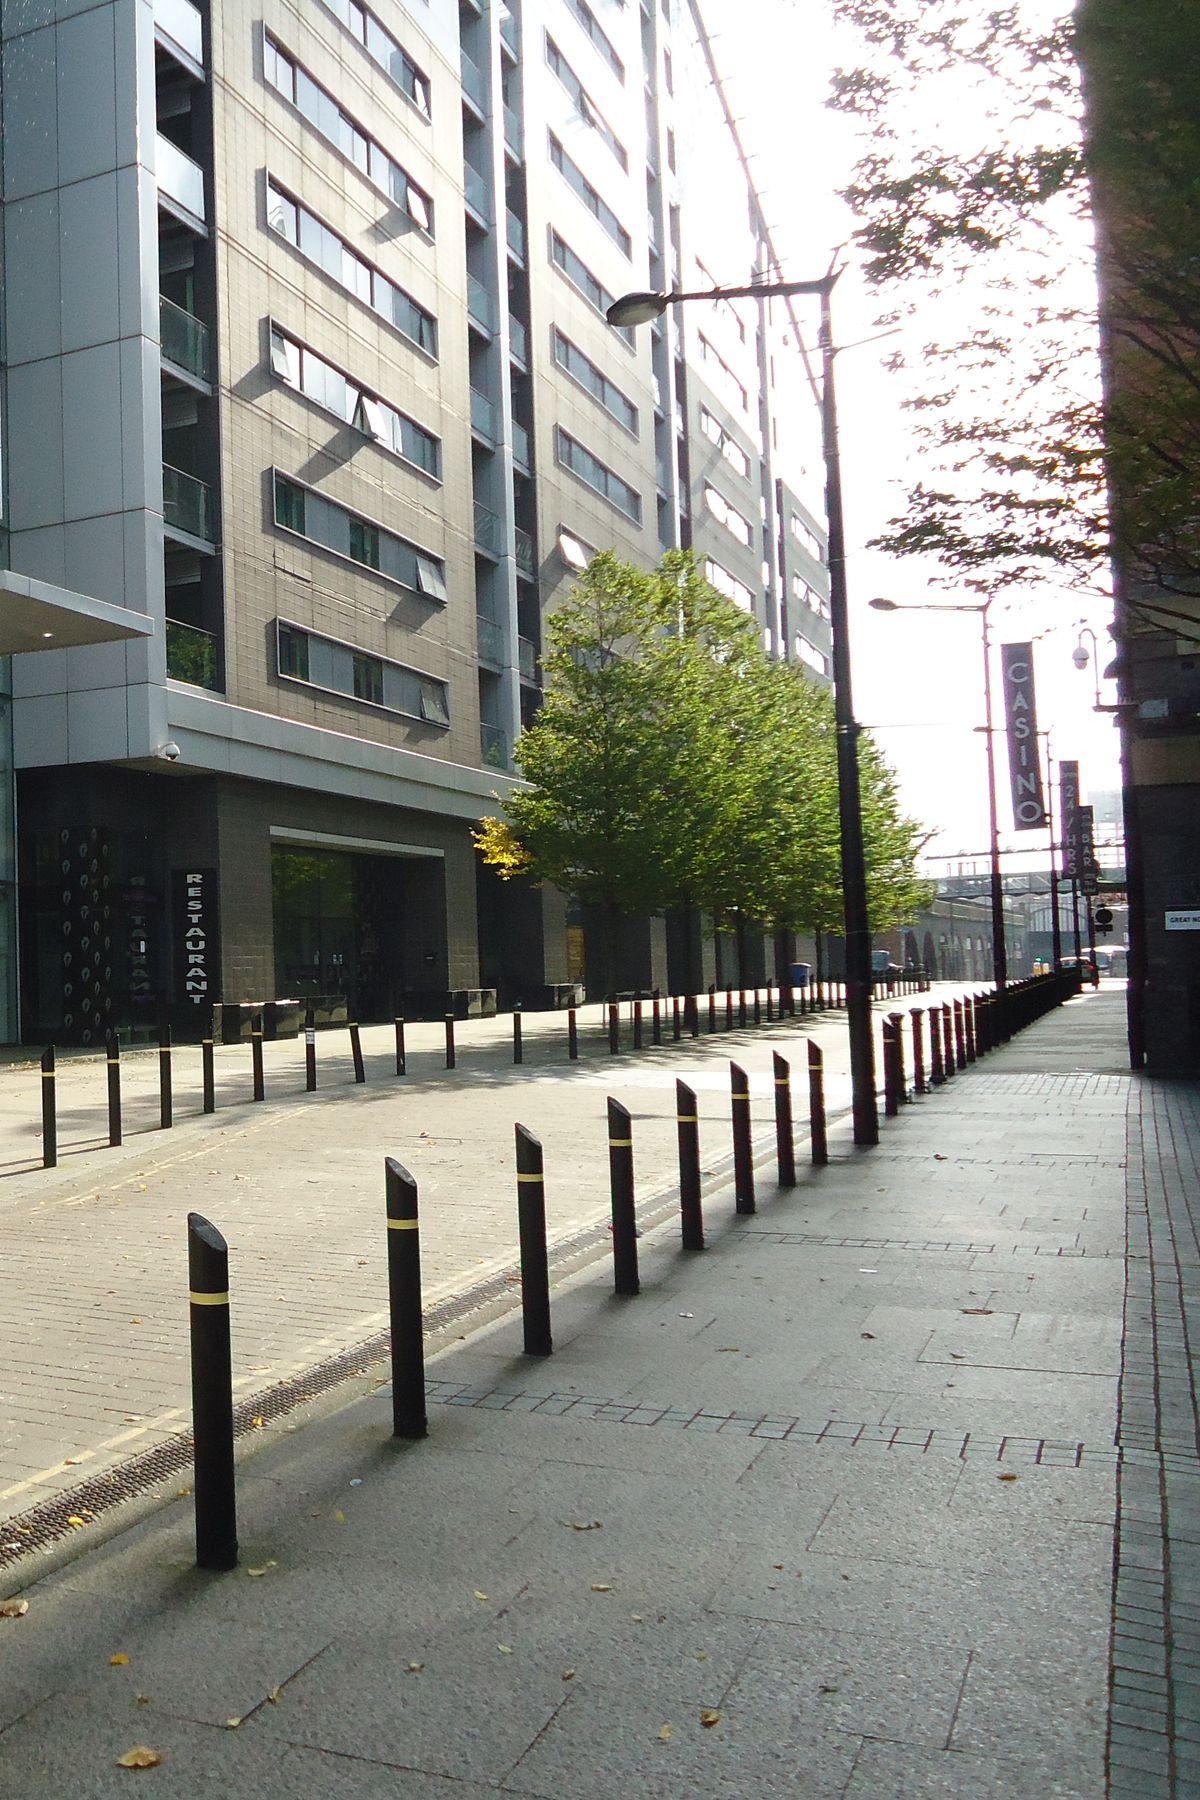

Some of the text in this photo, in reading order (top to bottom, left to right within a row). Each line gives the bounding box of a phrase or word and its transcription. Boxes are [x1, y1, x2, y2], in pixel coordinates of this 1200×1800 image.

[1007, 662, 1042, 823] CASINO
[1081, 833, 1092, 867] BAR
[185, 873, 207, 1004] RESTAURANT
